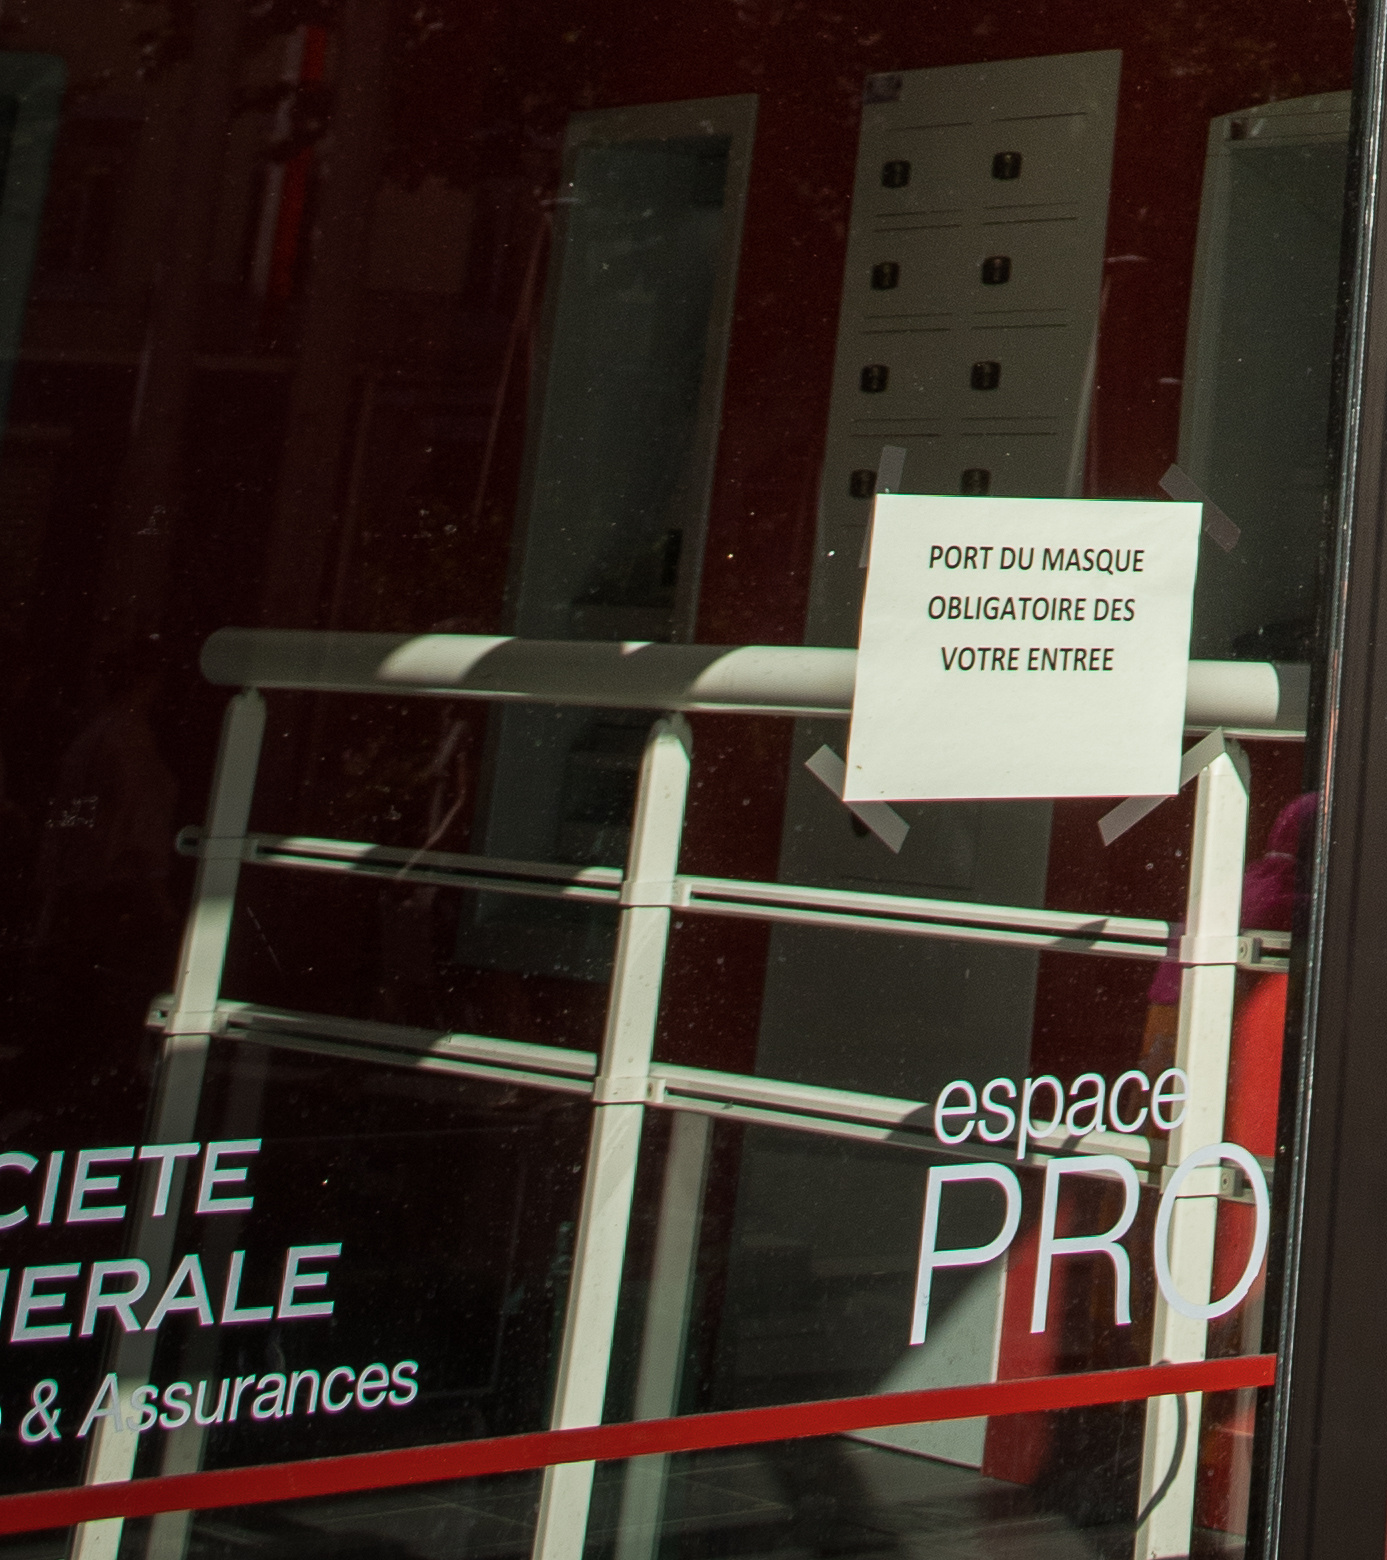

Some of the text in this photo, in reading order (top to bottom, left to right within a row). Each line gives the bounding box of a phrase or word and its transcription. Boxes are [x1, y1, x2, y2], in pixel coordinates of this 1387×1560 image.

[929, 545, 1145, 575] PORT DU MASQUE
[928, 595, 1136, 622] OBLIGATOIRE DES
[941, 646, 1115, 671] VOTRE ENTREE
[934, 1067, 1190, 1160] espace
[909, 1141, 1271, 1346] PRO
[0, 1242, 343, 1343] ERALE
[19, 1358, 419, 1443] & Assurances
